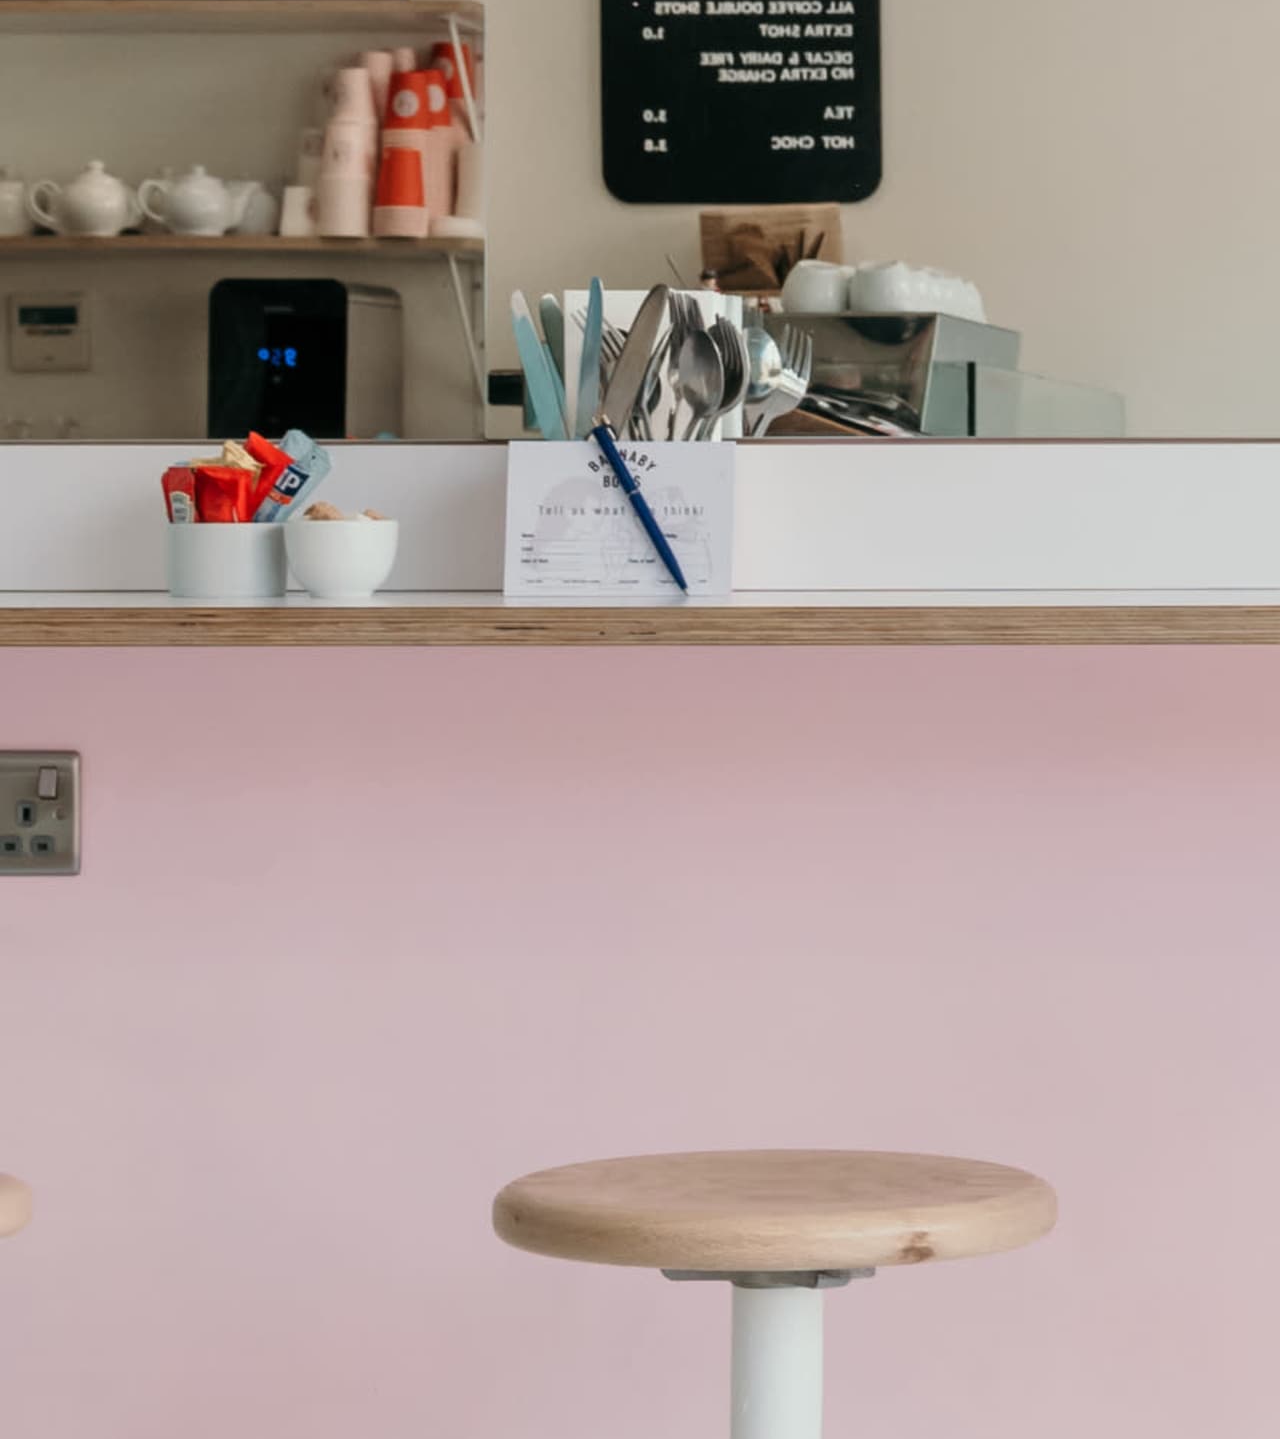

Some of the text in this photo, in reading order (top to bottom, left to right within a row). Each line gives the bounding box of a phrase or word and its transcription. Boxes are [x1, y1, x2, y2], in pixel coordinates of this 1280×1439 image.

[588, 448, 657, 473] BANABY
[539, 505, 564, 517] Tell
[571, 507, 586, 517] us
[594, 505, 627, 517] what
